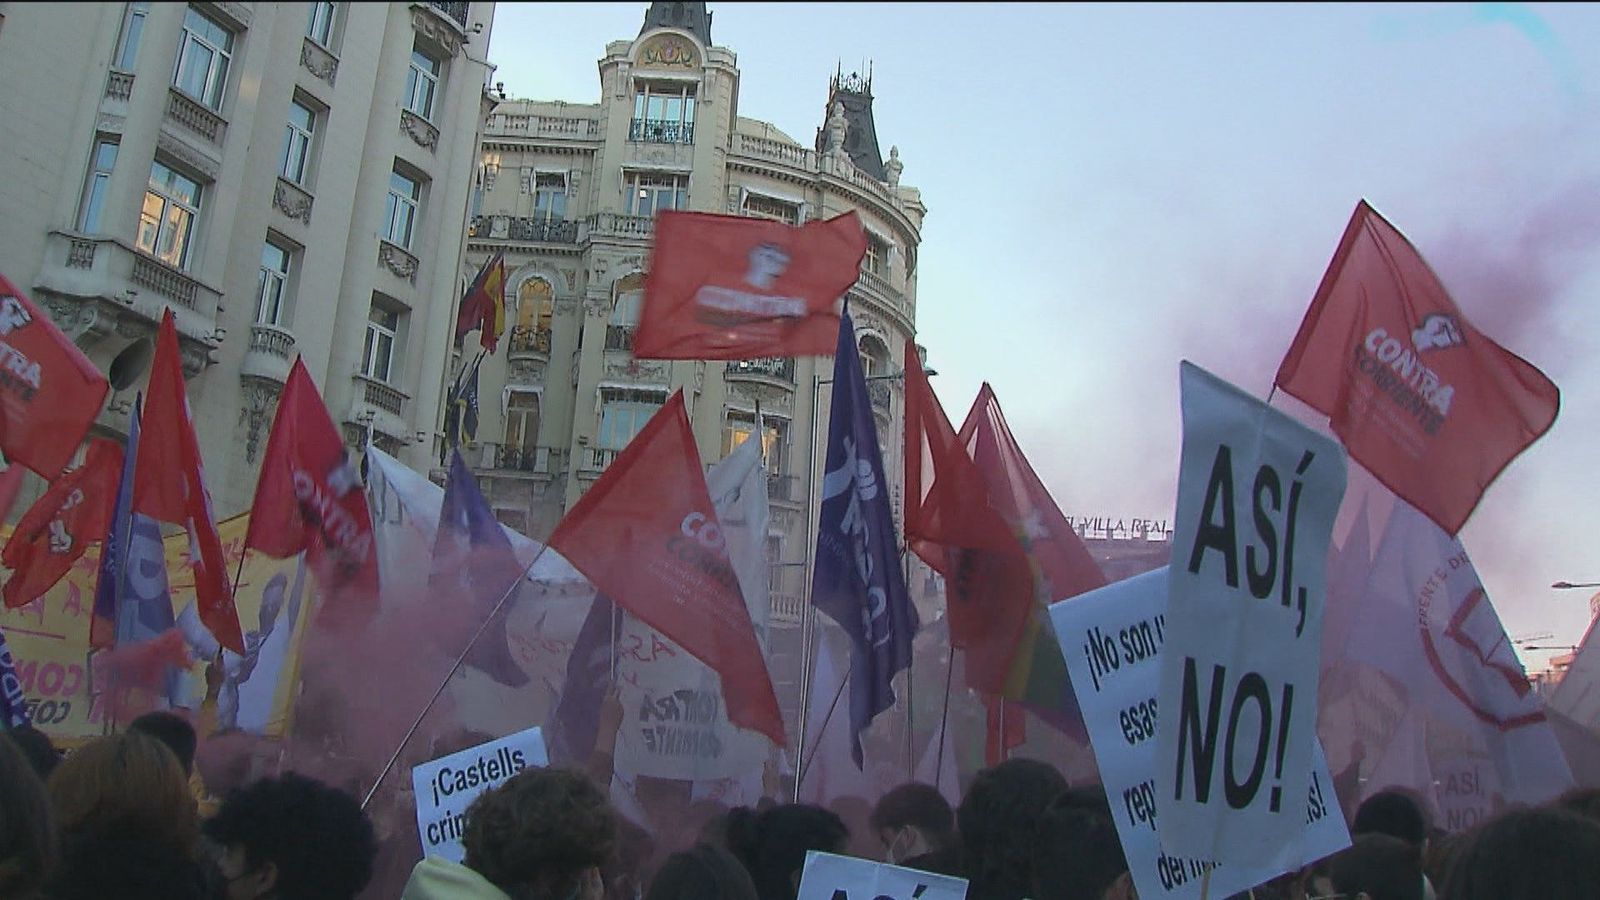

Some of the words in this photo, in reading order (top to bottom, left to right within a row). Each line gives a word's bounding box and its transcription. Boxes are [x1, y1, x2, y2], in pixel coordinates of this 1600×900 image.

[1365, 328, 1455, 416] CONTRA
[1083, 515, 1125, 532] VILLA
[1131, 518, 1168, 534] REAL
[1188, 443, 1315, 638] ASÍ,
[1083, 625, 1121, 693] ¡No
[1119, 620, 1158, 665] son
[1174, 655, 1294, 814] NO!
[430, 745, 527, 807] ¡Castells
